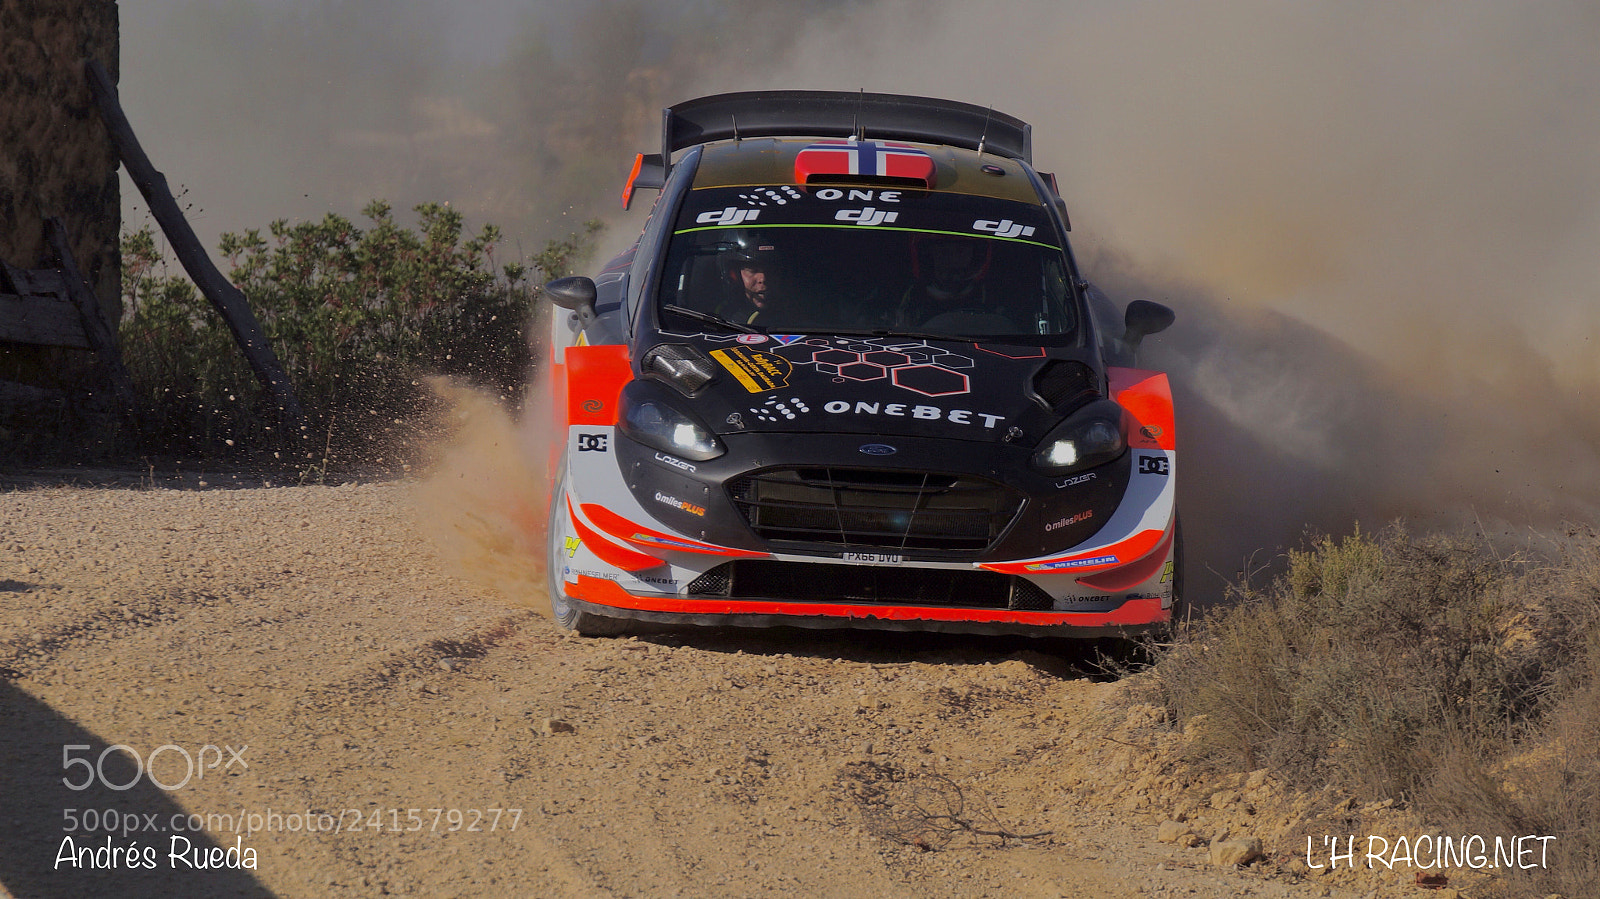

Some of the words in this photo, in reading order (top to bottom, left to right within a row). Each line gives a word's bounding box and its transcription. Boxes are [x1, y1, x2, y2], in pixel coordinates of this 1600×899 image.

[815, 188, 902, 203] ONE
[823, 400, 1006, 429] ONEBET
[578, 433, 607, 452] DC
[1139, 455, 1169, 475] DC
[1054, 556, 1115, 569] MICHELIN
[645, 576, 678, 585] ONEBET
